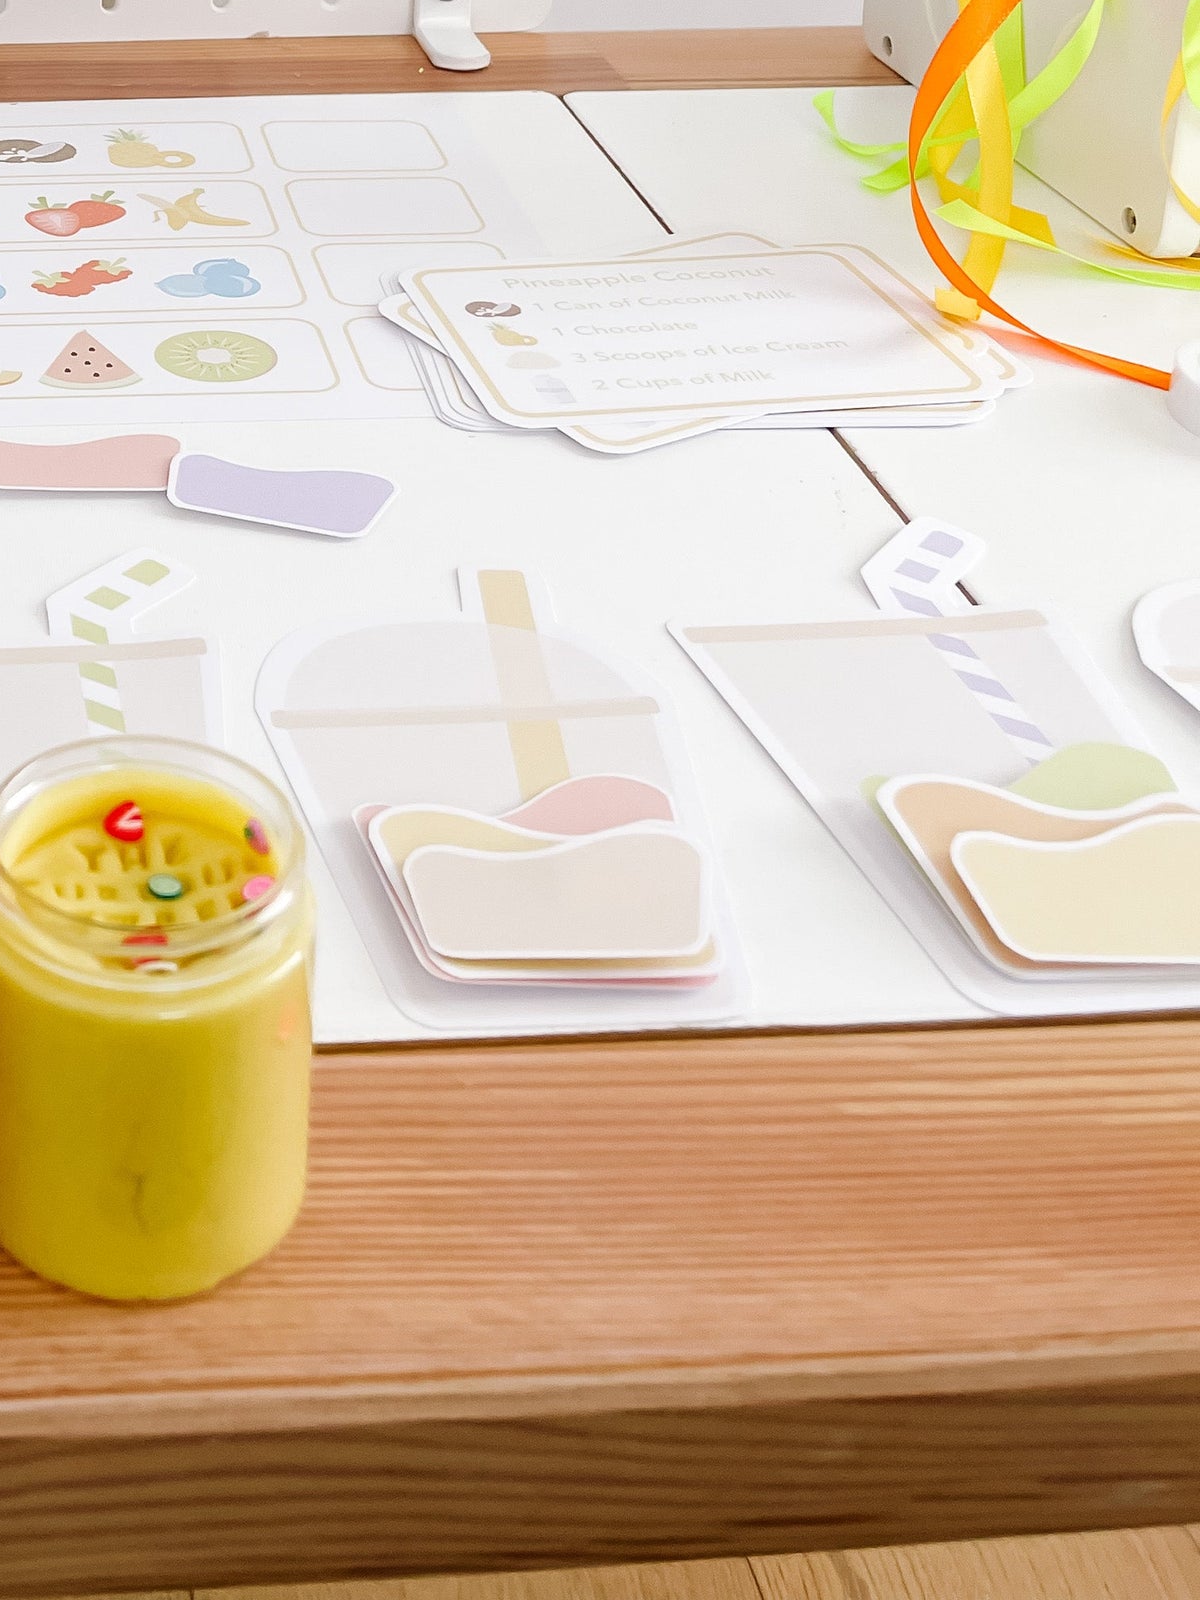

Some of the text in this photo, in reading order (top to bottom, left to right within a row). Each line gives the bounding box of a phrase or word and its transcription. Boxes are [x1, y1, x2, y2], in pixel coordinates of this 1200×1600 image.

[502, 266, 775, 291] Pineapple Coconut
[532, 288, 798, 312] 1 Can of Coconut Milk
[551, 318, 699, 337] 1 Chocolate
[573, 337, 851, 364] 3 Scoops of Ice Cream
[590, 368, 775, 392] 2 Cups of Milk
